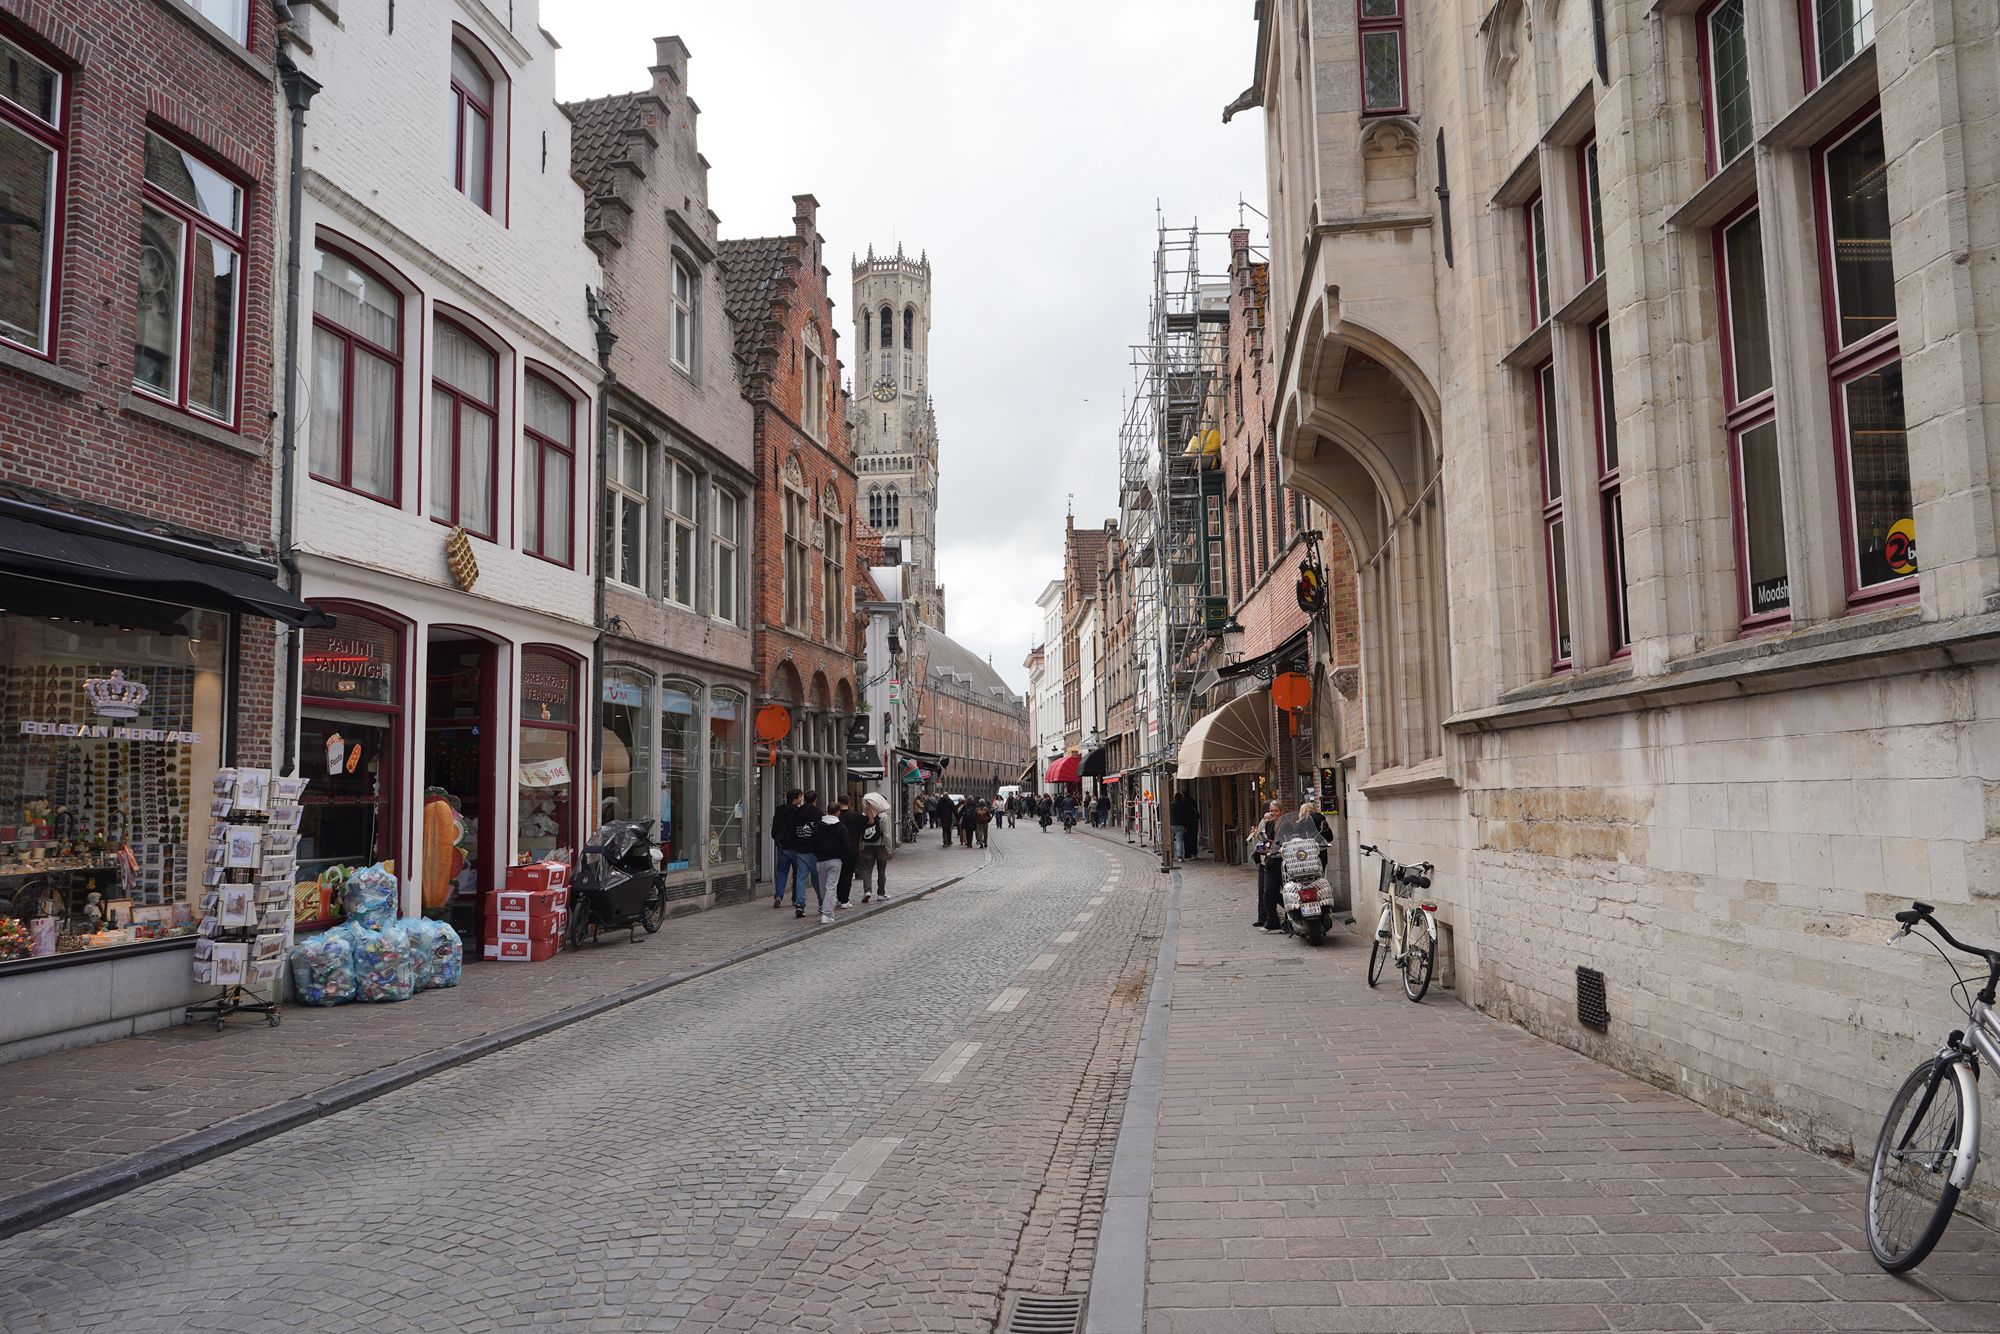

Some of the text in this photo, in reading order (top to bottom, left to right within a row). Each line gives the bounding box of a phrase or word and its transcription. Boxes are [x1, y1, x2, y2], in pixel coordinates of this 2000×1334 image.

[327, 637, 374, 657] PANINI
[315, 657, 385, 679] SANDWICH
[527, 688, 566, 704] TEAROOM
[113, 726, 203, 744] HERITAGE
[550, 766, 565, 778] 10€
[1209, 762, 1255, 775] Chocolates
